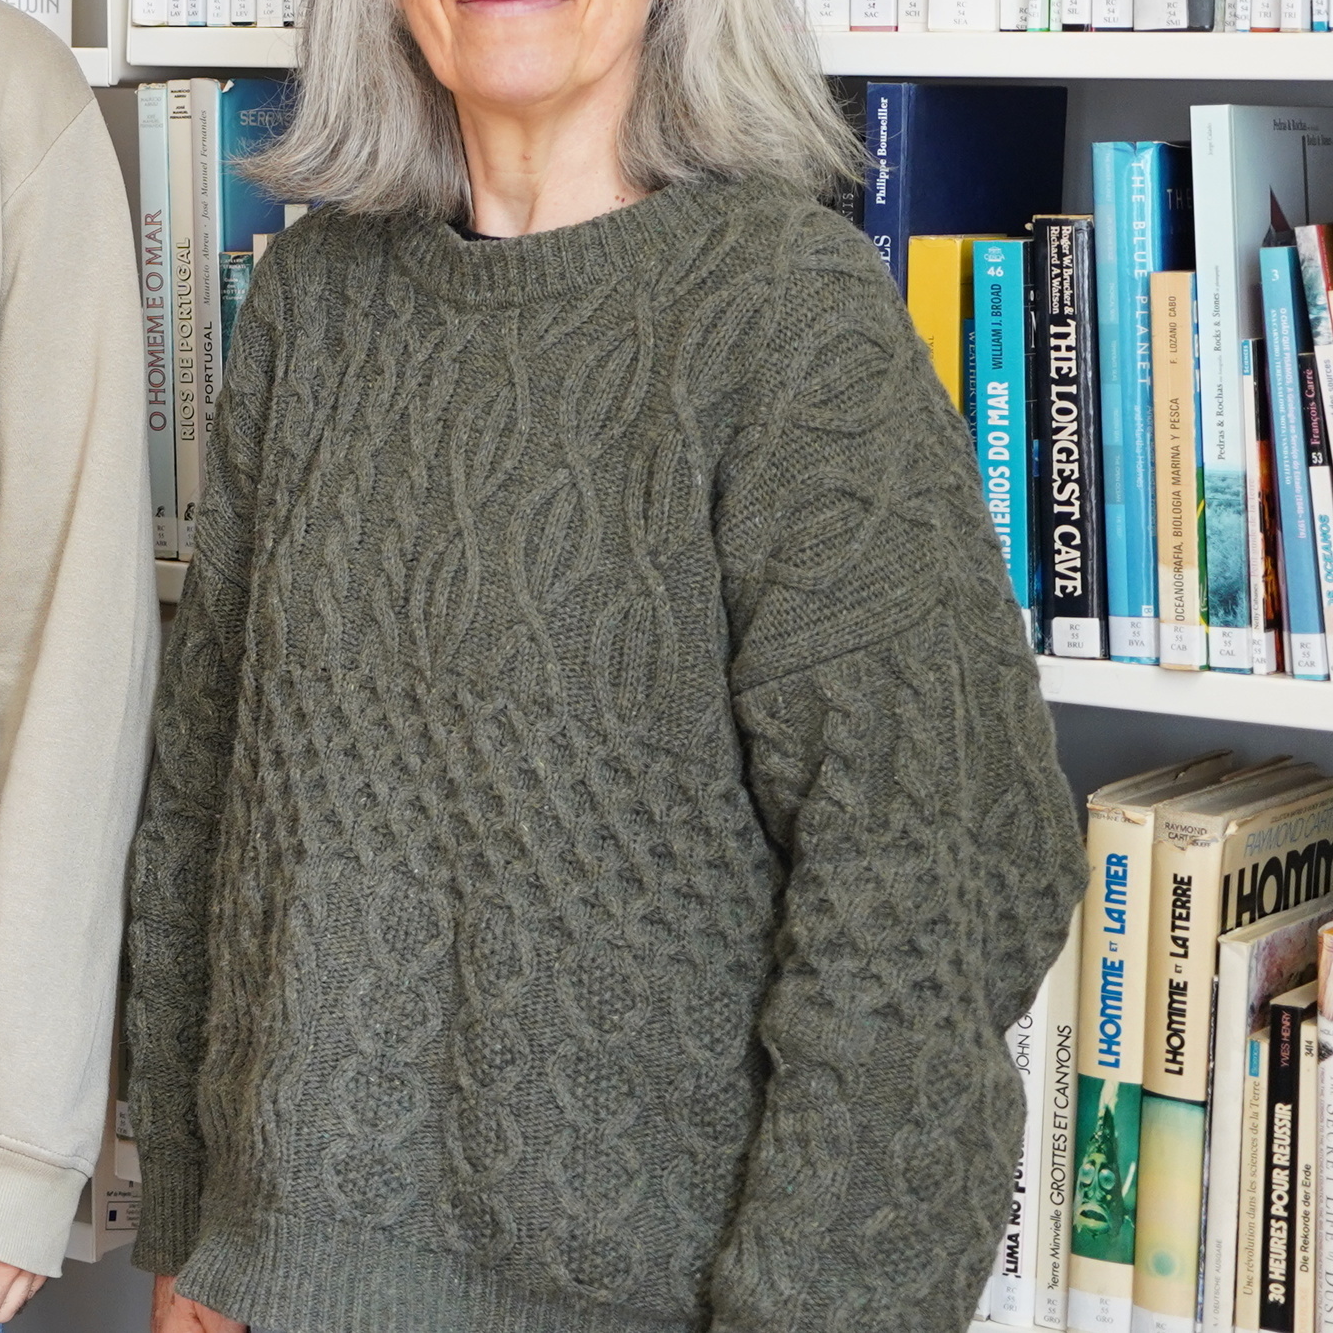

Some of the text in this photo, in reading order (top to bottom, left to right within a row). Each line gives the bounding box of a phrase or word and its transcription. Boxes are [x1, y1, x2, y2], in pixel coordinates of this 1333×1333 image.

[875, 97, 888, 205] Philippe Bourseiller
[143, 209, 166, 406] HOMEM MAR
[175, 237, 196, 441] RIOS DE PORTUGAL
[986, 267, 1004, 278] 46
[1132, 220, 1151, 386] BLUE PLANET
[986, 381, 1011, 461] DO MAR
[1050, 320, 1083, 599] THE LONGEST CAVE
[1171, 397, 1184, 540] BIOLOGIA MARINA PESCA
[1164, 821, 1207, 836] RAYMOND
[1048, 1024, 1074, 1207] GROTTES CANYONS
[1304, 1039, 1314, 1058] 3414
[1267, 1102, 1292, 1277] HEURES POUR REUSSIR
